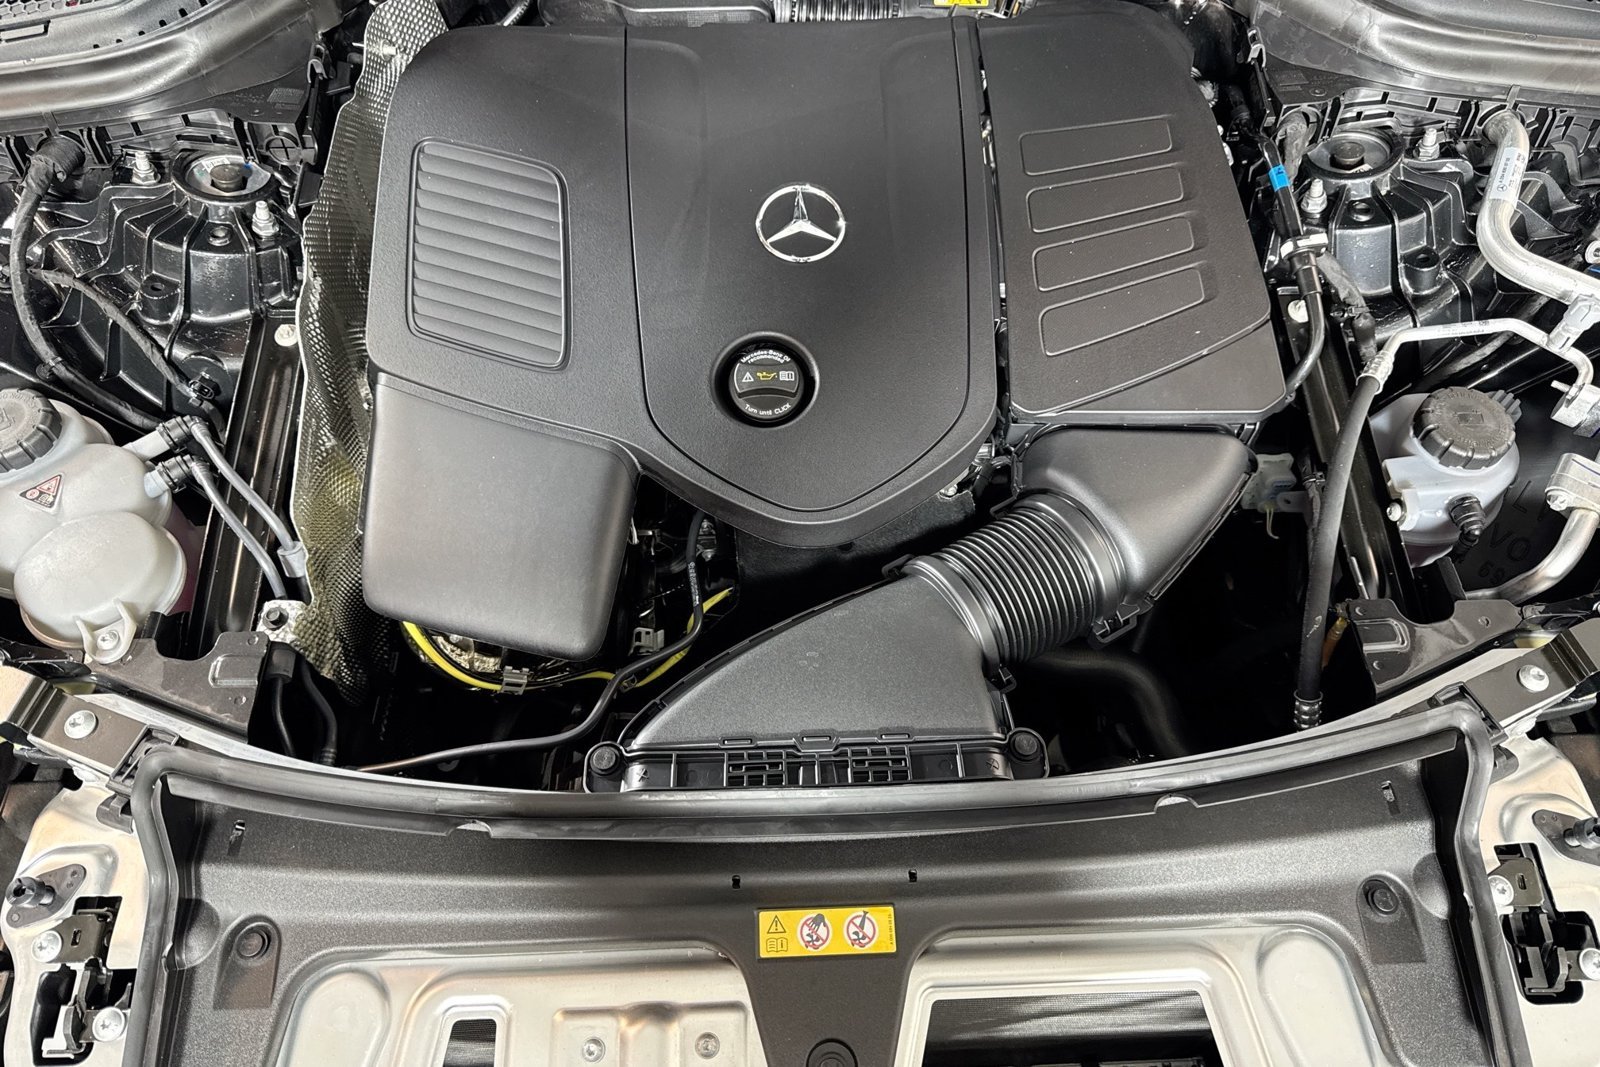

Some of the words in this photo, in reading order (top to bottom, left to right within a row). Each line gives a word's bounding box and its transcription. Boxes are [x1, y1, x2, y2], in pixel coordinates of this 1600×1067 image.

[740, 349, 783, 363] Mercedes-Benz
[747, 354, 785, 364] recommended
[744, 403, 758, 414] Turn
[774, 402, 792, 415] CLICK
